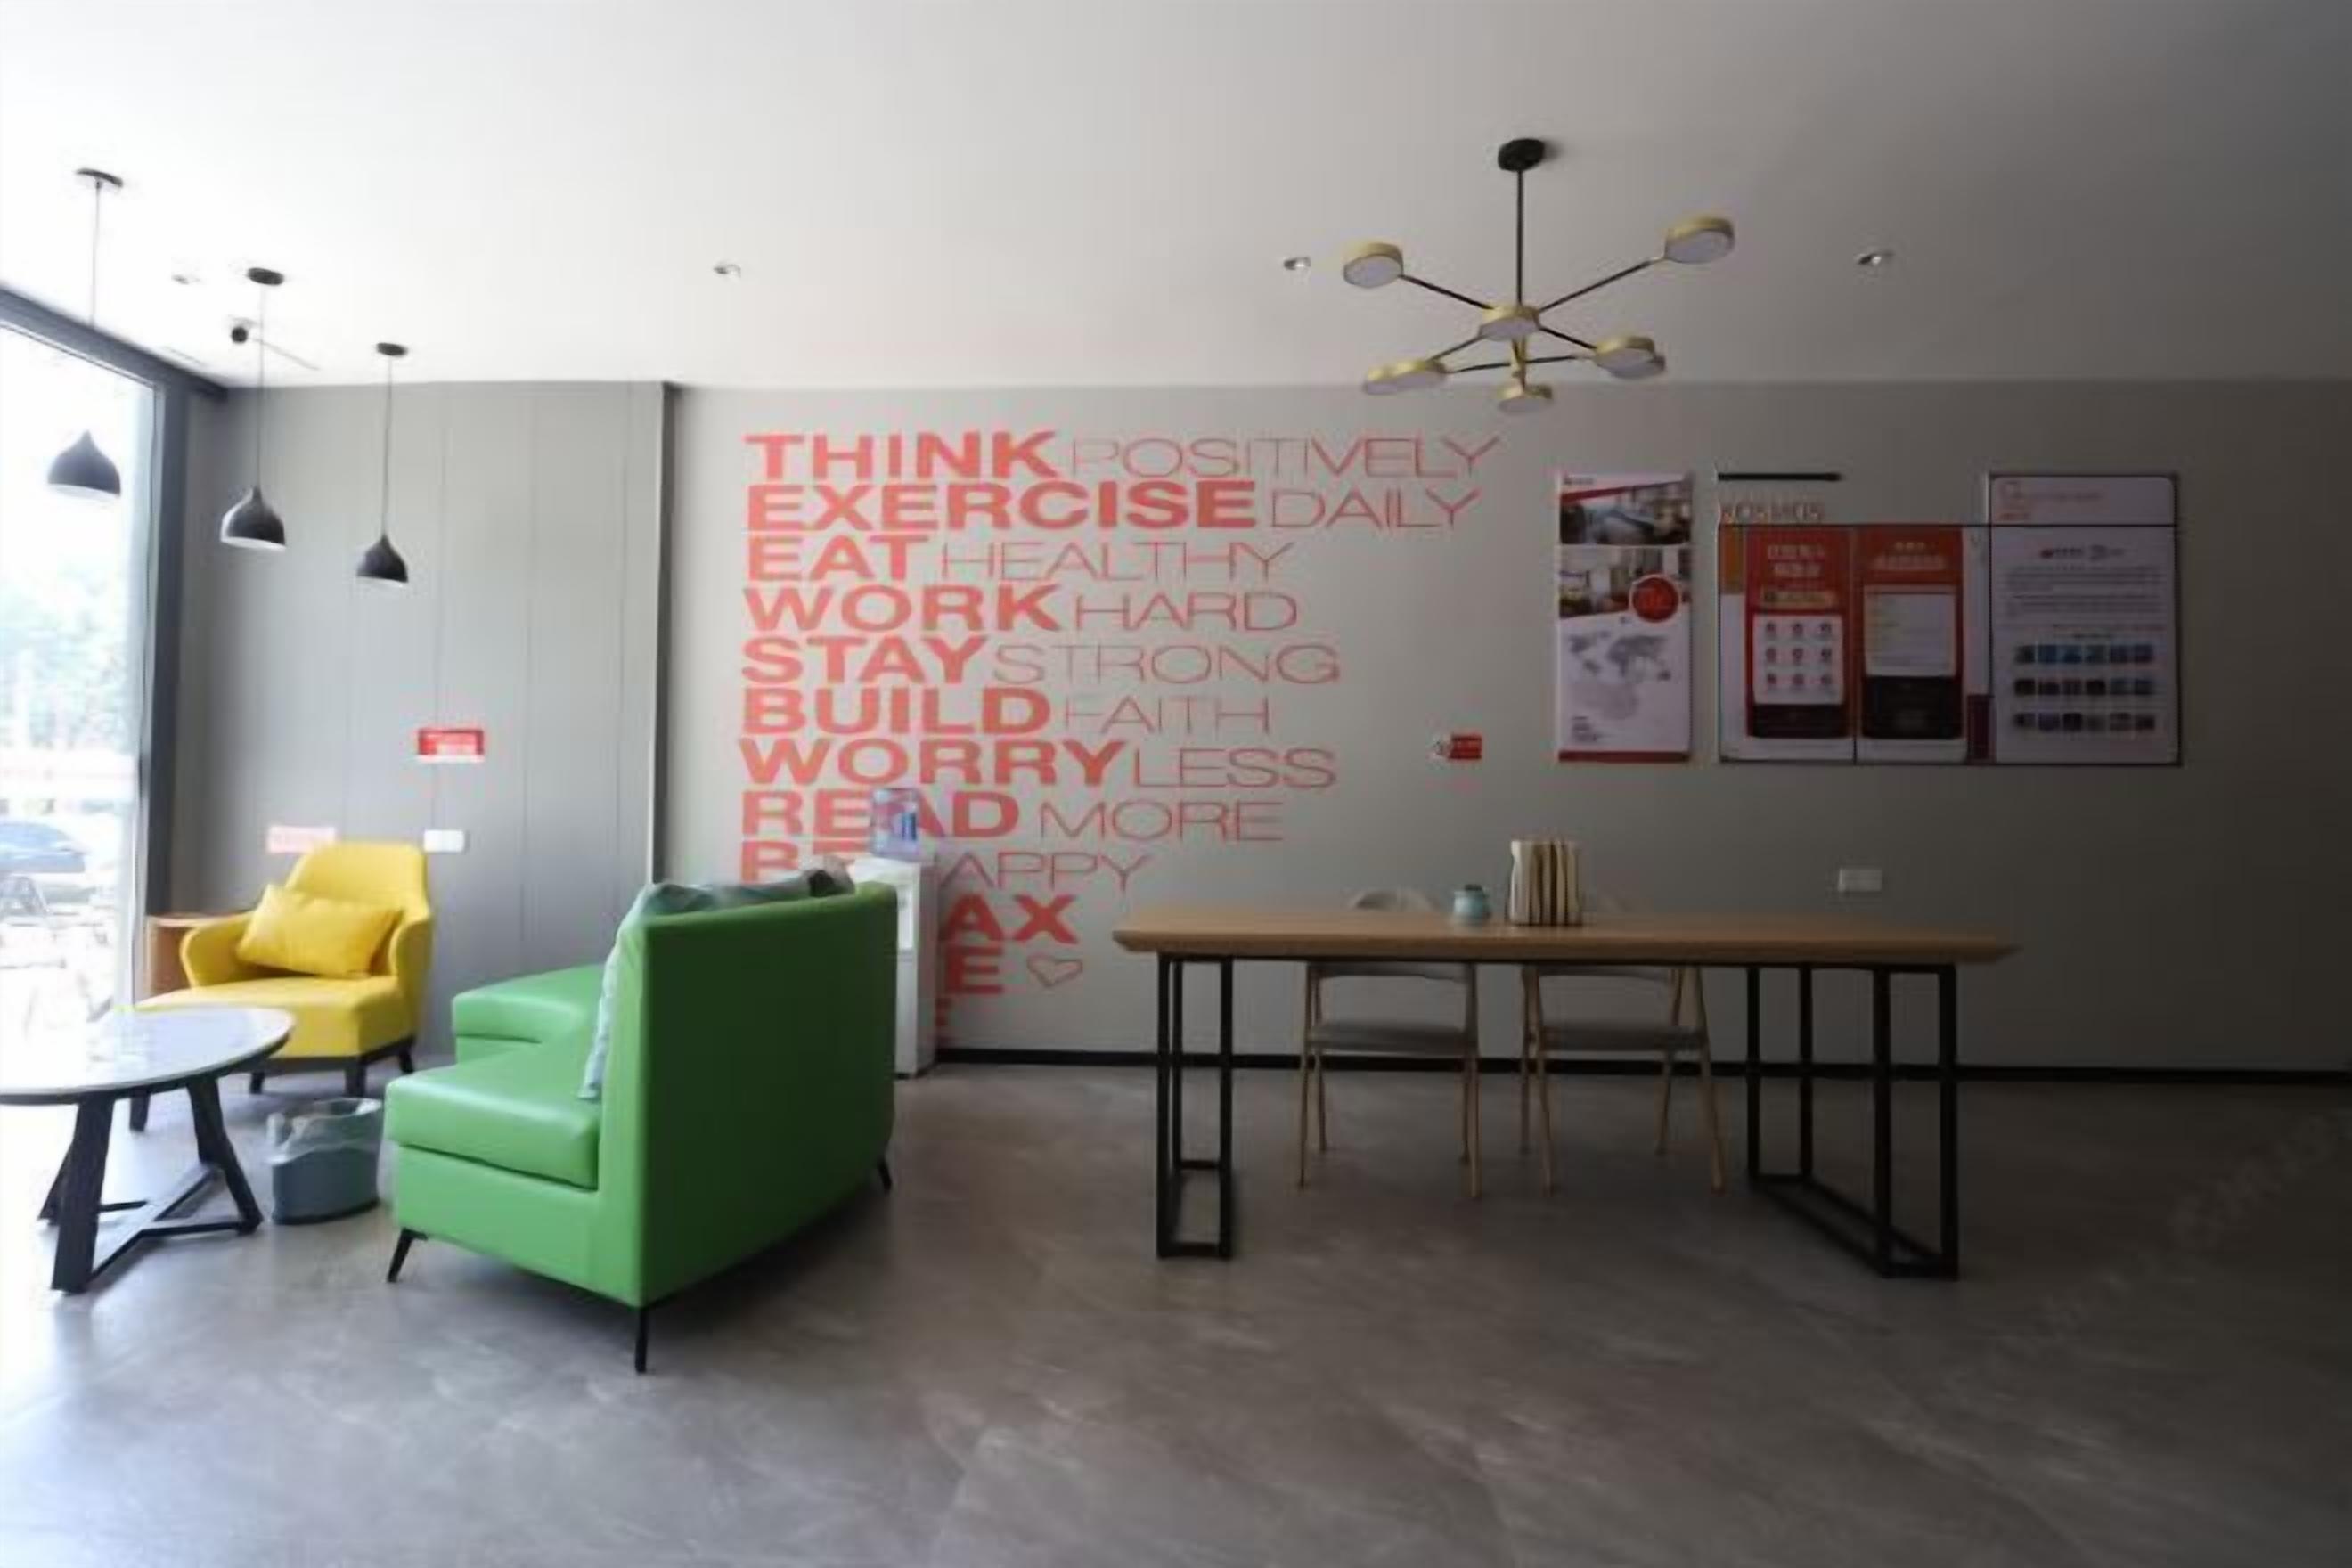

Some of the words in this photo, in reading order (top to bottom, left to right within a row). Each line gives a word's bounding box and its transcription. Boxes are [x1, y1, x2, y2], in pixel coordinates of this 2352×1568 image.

[745, 431, 1058, 478] THINK
[1072, 436, 1501, 478] POSITIVELY
[745, 482, 1256, 530] EXERCISE
[1271, 488, 1481, 528] DAILY
[745, 535, 927, 582] EAT
[942, 542, 1295, 582] HEALTHY
[742, 584, 1062, 633] WORK
[1074, 592, 1298, 632] HARD
[741, 636, 988, 685] STAY
[993, 643, 1340, 683] STRONG
[741, 687, 1051, 736] BUILD
[1066, 694, 1270, 734] FAITH
[739, 739, 1126, 788] WORRY
[1132, 748, 1336, 789] LESS
[1040, 799, 1284, 842] MORE
[934, 852, 1153, 891] APPY
